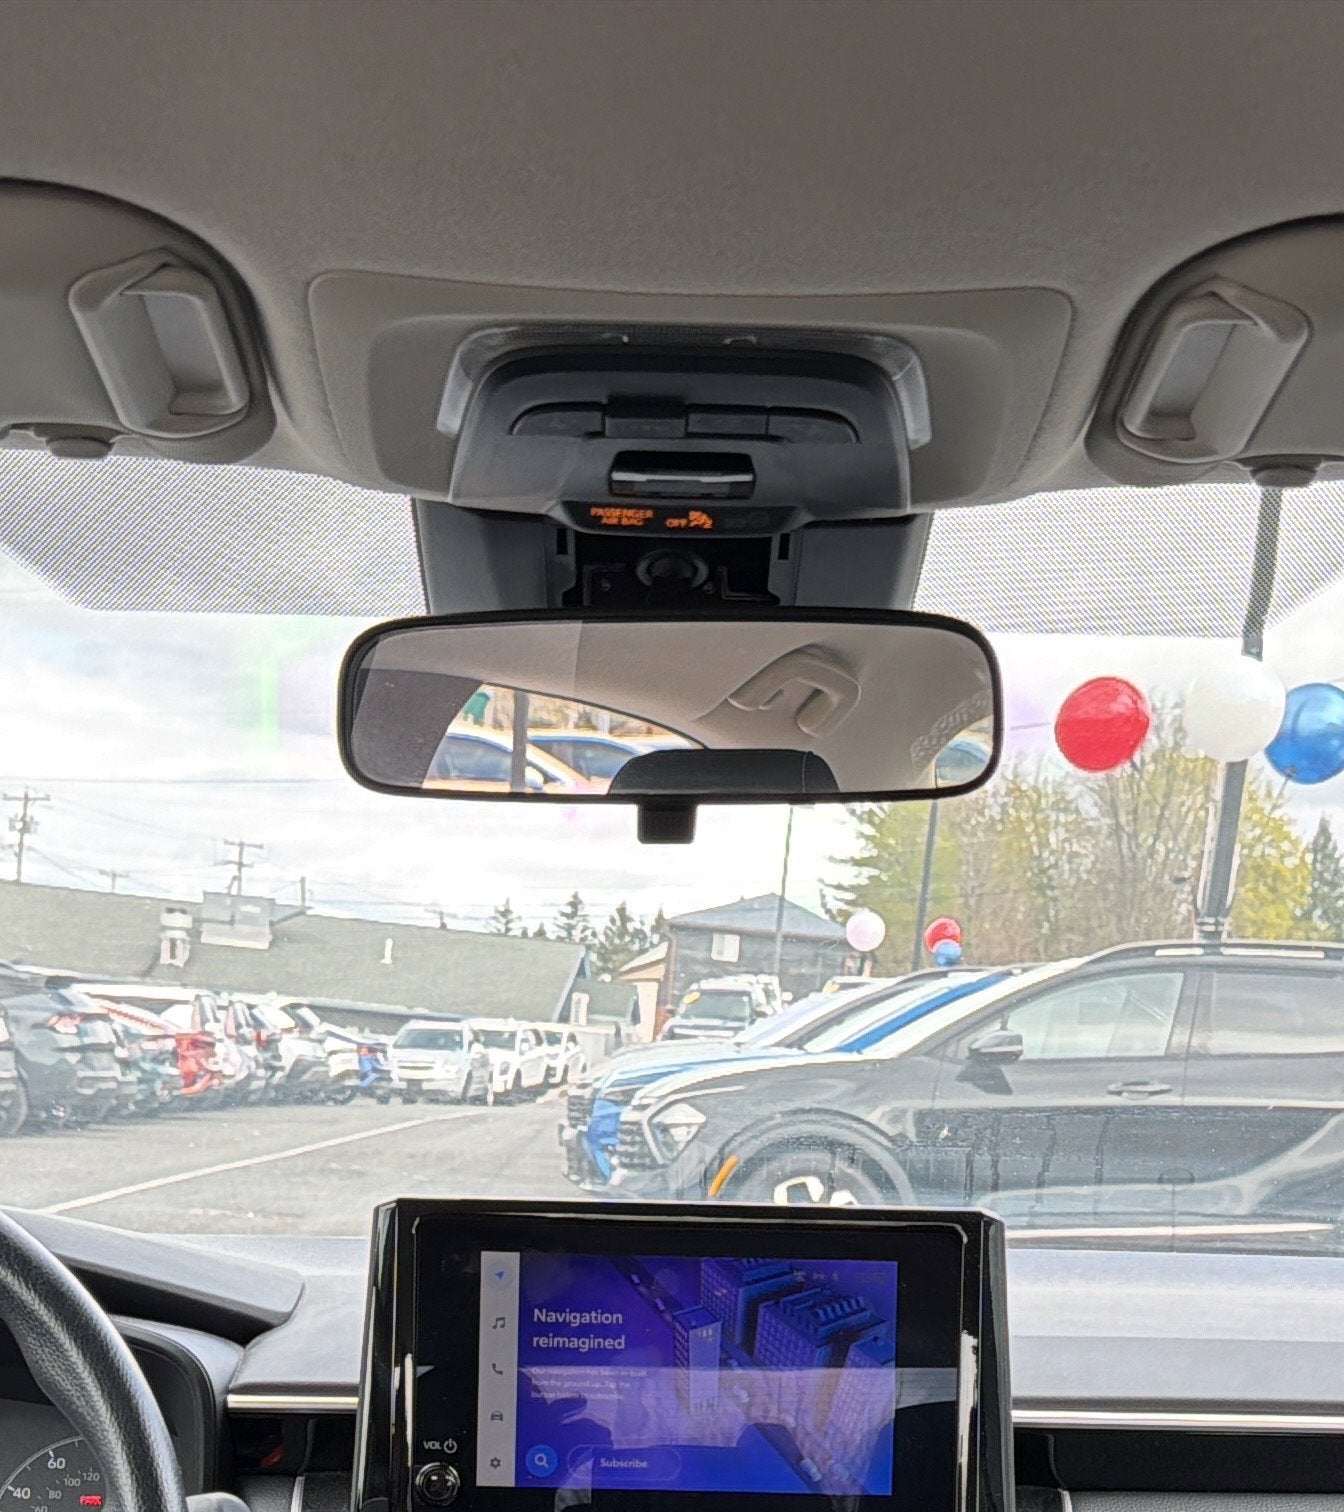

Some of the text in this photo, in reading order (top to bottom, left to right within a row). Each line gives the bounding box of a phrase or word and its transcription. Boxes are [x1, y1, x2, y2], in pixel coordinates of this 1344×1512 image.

[590, 507, 654, 518] PASSENGER
[601, 517, 644, 527] AIR BAG
[665, 518, 688, 528] OFF
[533, 1308, 623, 1326] Navigation
[532, 1335, 625, 1352] reimagined
[423, 1440, 442, 1450] VOL
[47, 1457, 66, 1469] 60
[600, 1457, 648, 1468] Subscribe
[82, 1472, 100, 1481] 120
[63, 1477, 81, 1487] 100
[12, 1487, 31, 1499] 40
[48, 1490, 62, 1499] 80
